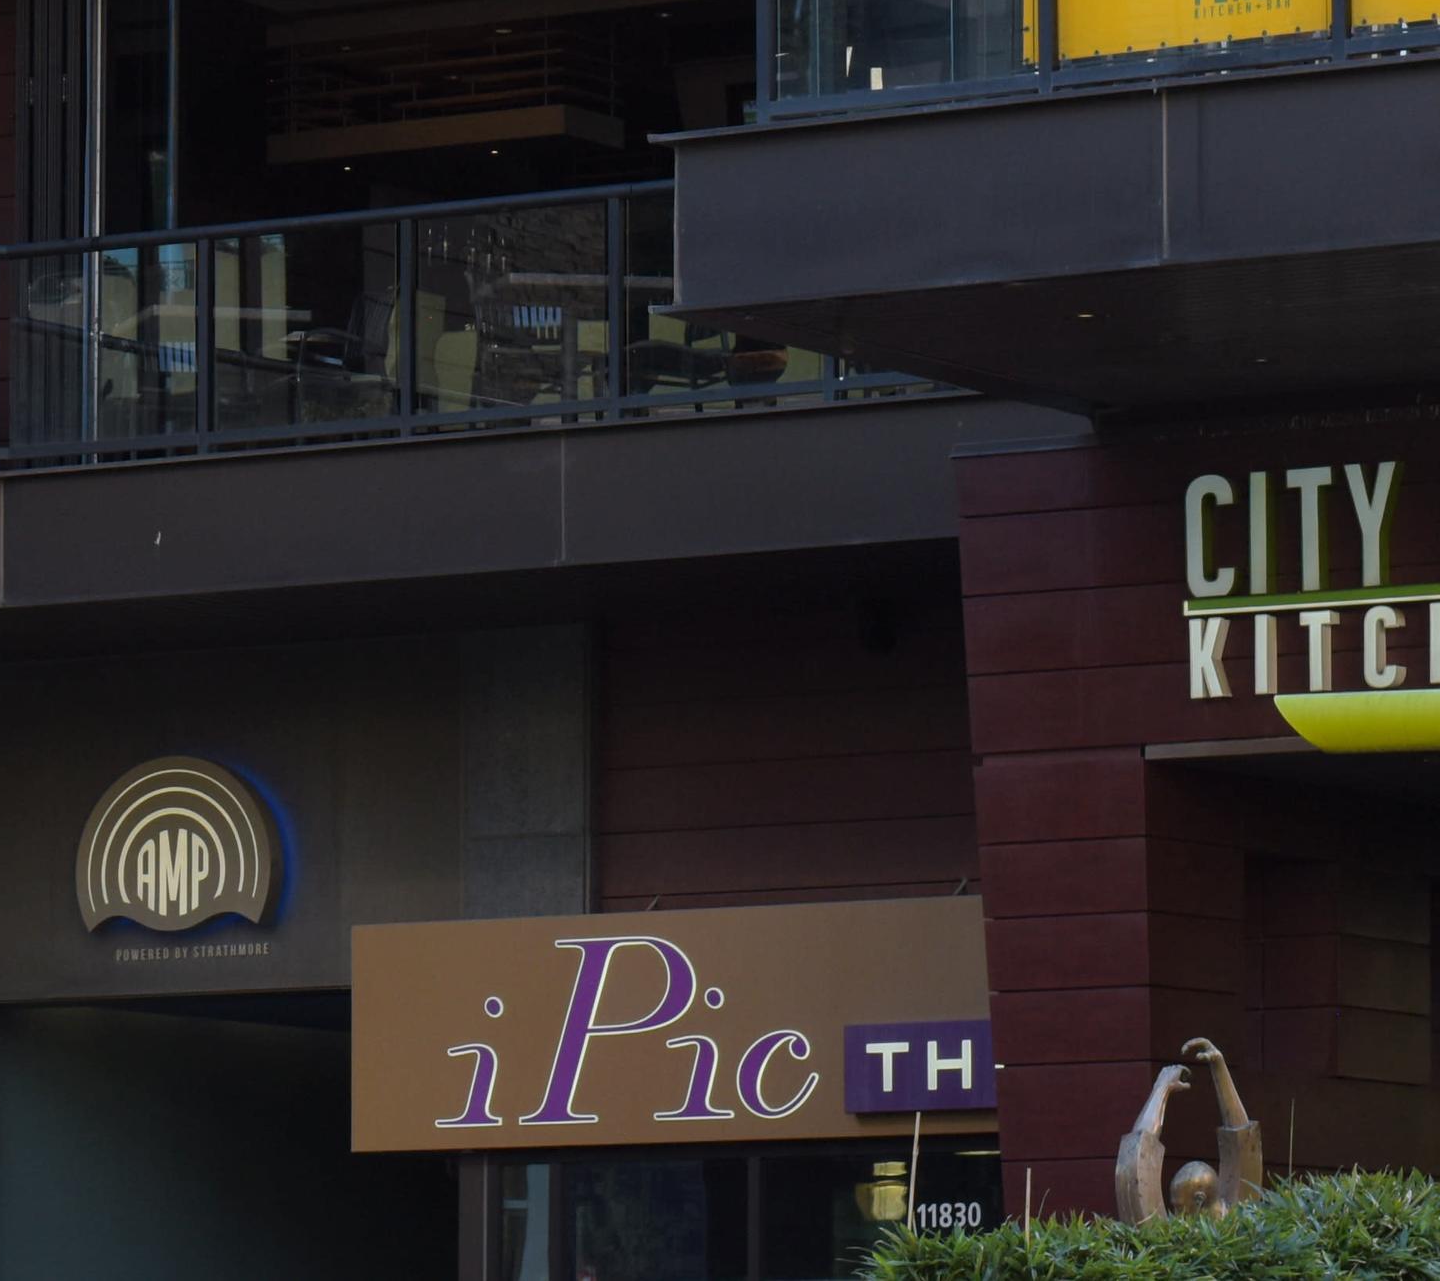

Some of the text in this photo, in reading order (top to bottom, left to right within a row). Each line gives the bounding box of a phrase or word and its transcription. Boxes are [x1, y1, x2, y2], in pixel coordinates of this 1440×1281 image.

[1184, 460, 1404, 598] CITY
[136, 828, 210, 916] AMP
[116, 942, 270, 963] POWERED BY STRATHMORE
[434, 934, 820, 1128] iPic
[916, 1201, 981, 1229] 11830
